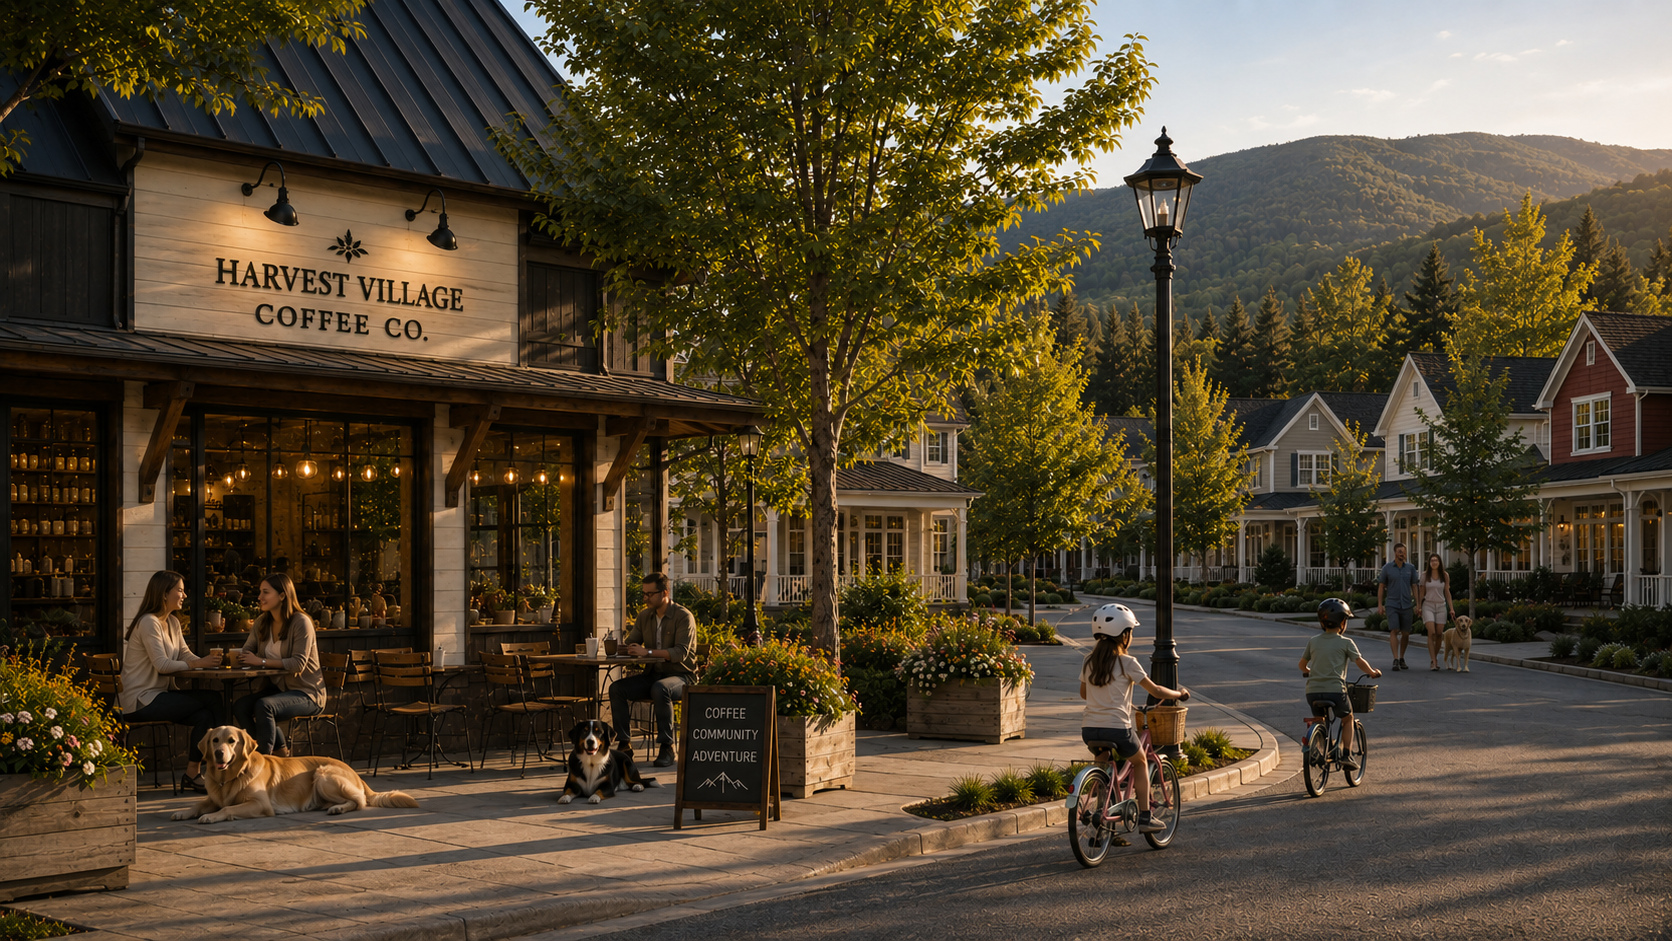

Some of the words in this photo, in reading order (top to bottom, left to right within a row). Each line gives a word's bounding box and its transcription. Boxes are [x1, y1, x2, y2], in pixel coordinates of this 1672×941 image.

[215, 257, 350, 297] HARVEST
[357, 276, 464, 312] VILLAGE
[255, 303, 370, 335] COFFEE
[385, 317, 428, 342] CO.
[705, 707, 746, 719] COFFEE
[692, 728, 759, 740] COMMUNITY
[692, 750, 757, 762] ADVENTURE
